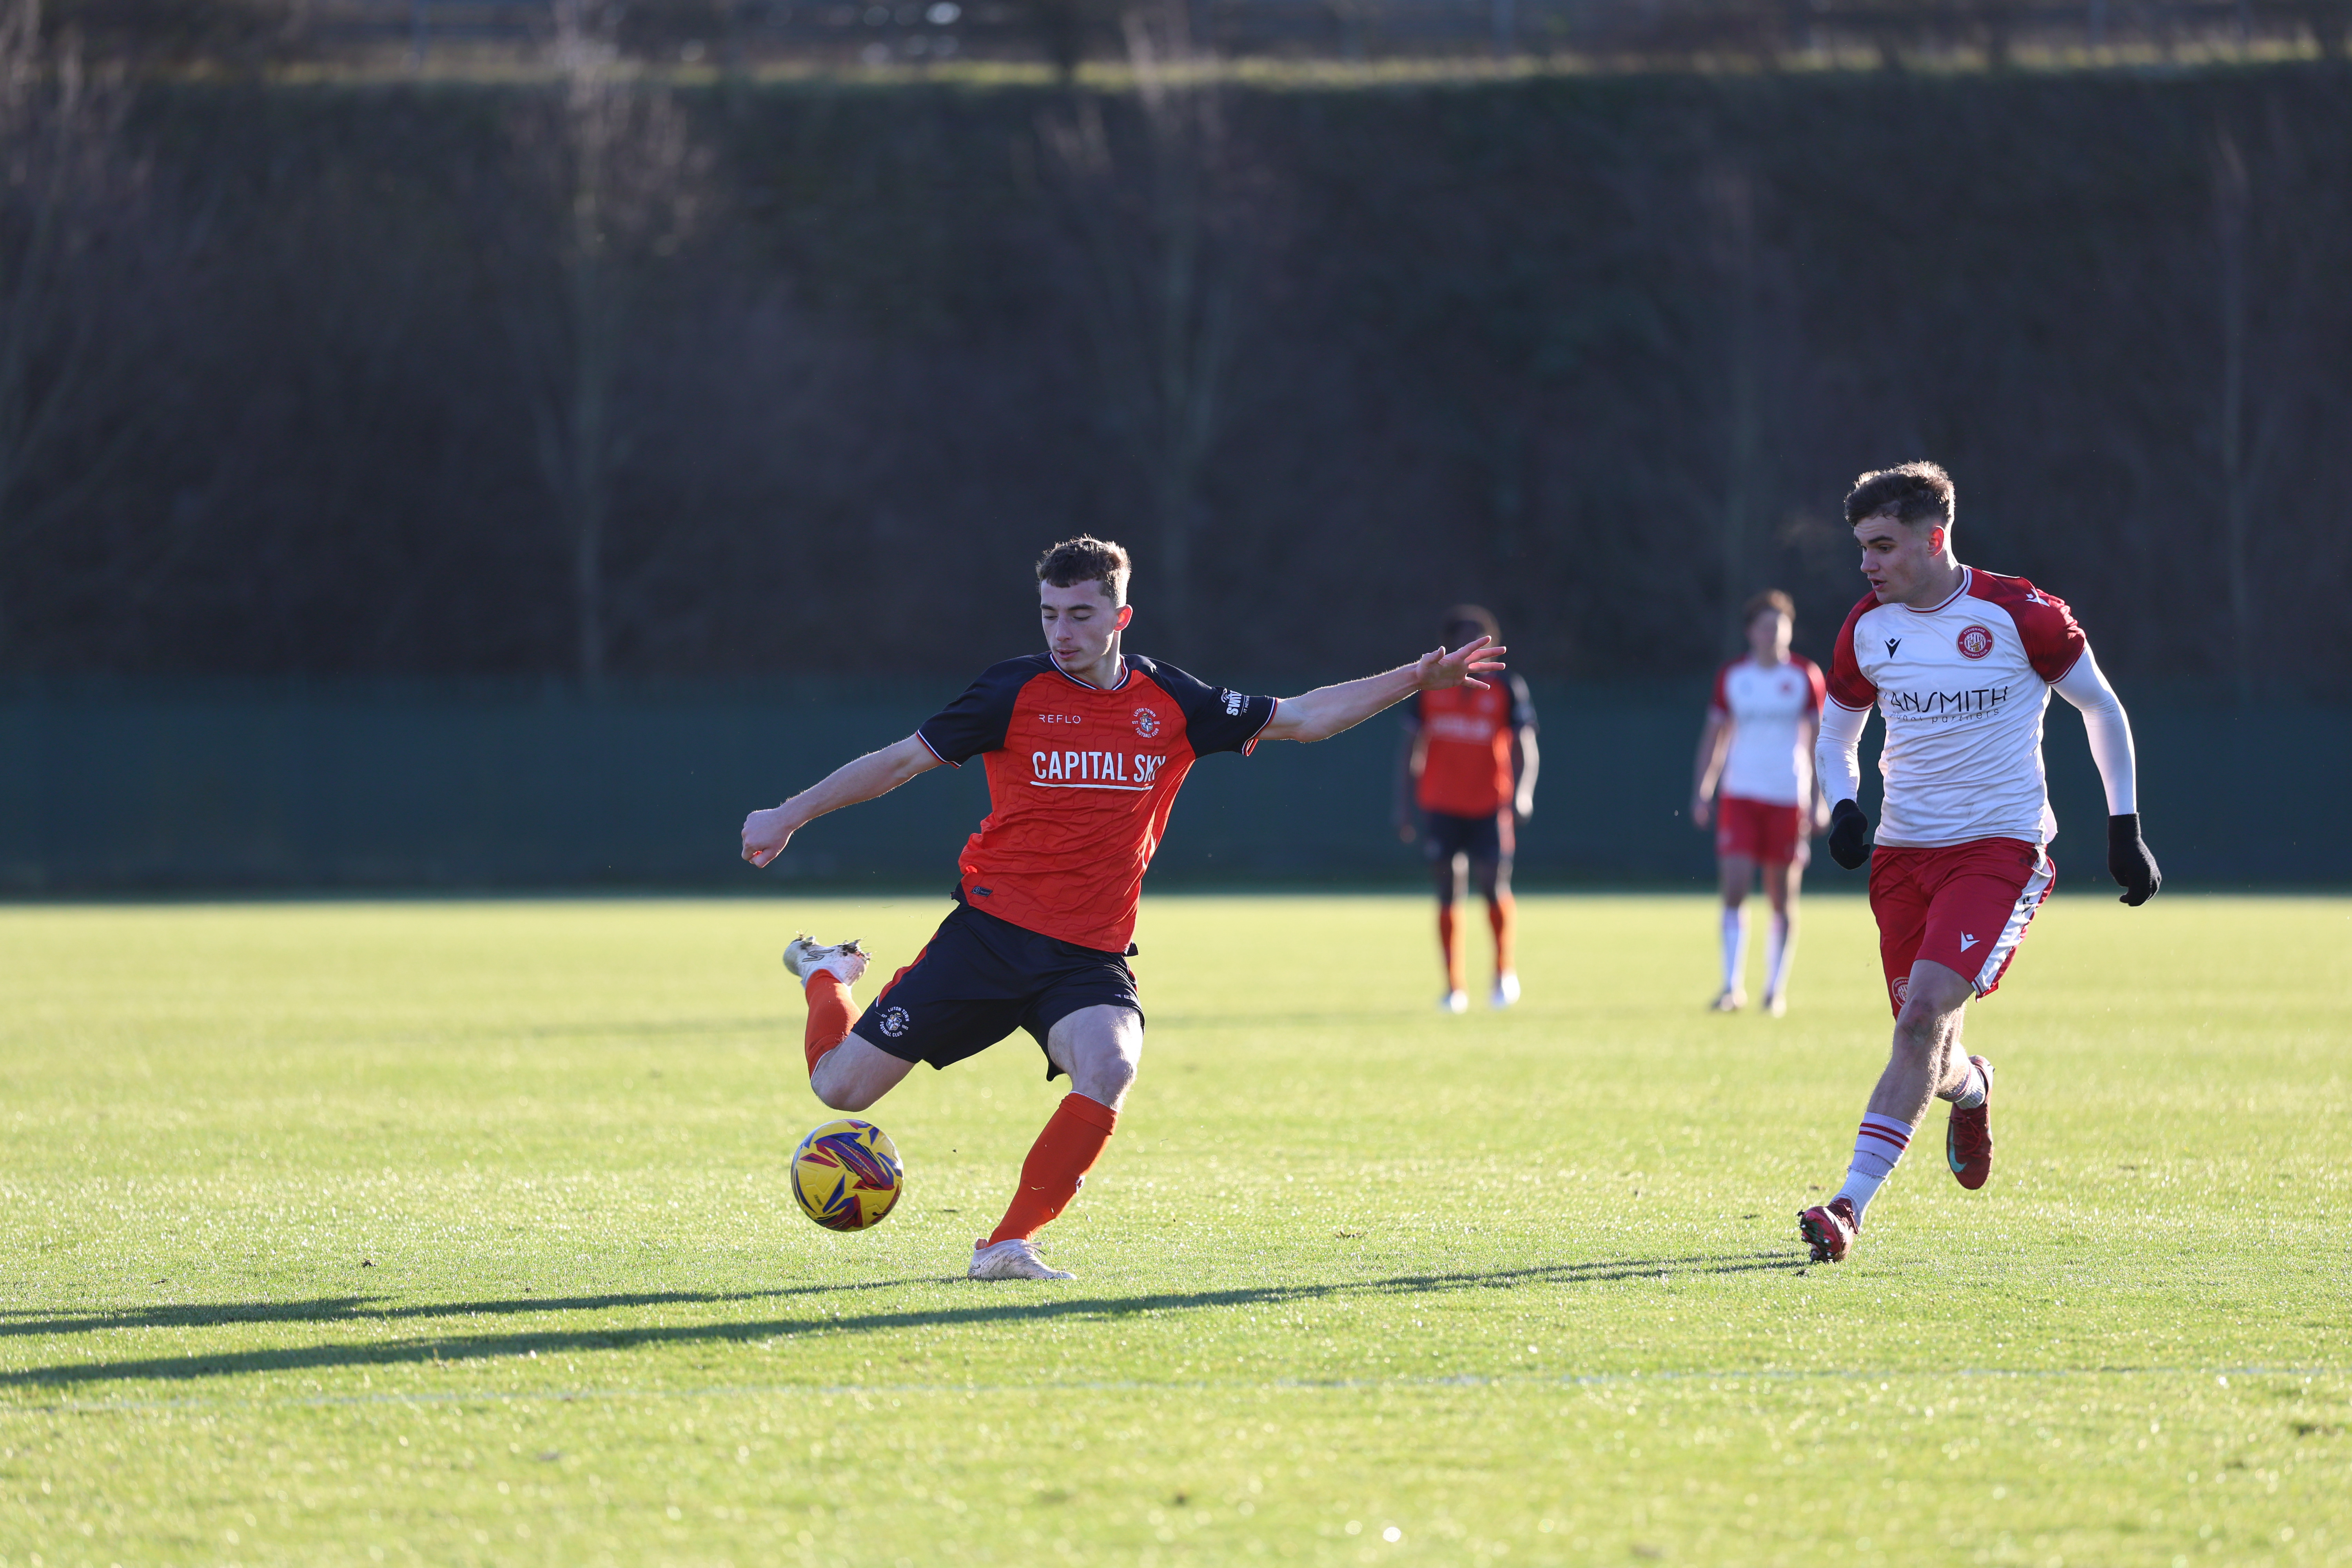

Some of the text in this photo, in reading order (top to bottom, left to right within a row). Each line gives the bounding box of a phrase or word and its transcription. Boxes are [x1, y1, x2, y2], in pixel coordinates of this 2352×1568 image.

[1884, 686, 2007, 713] ANSMITH
[1133, 708, 1156, 717] LUTON TOWN
[1039, 715, 1081, 724] REFLO
[1135, 728, 1152, 738] FOOTBALL
[1032, 751, 1166, 782] CAPITAL SKY
[880, 1021, 891, 1036] FOOTBALL
